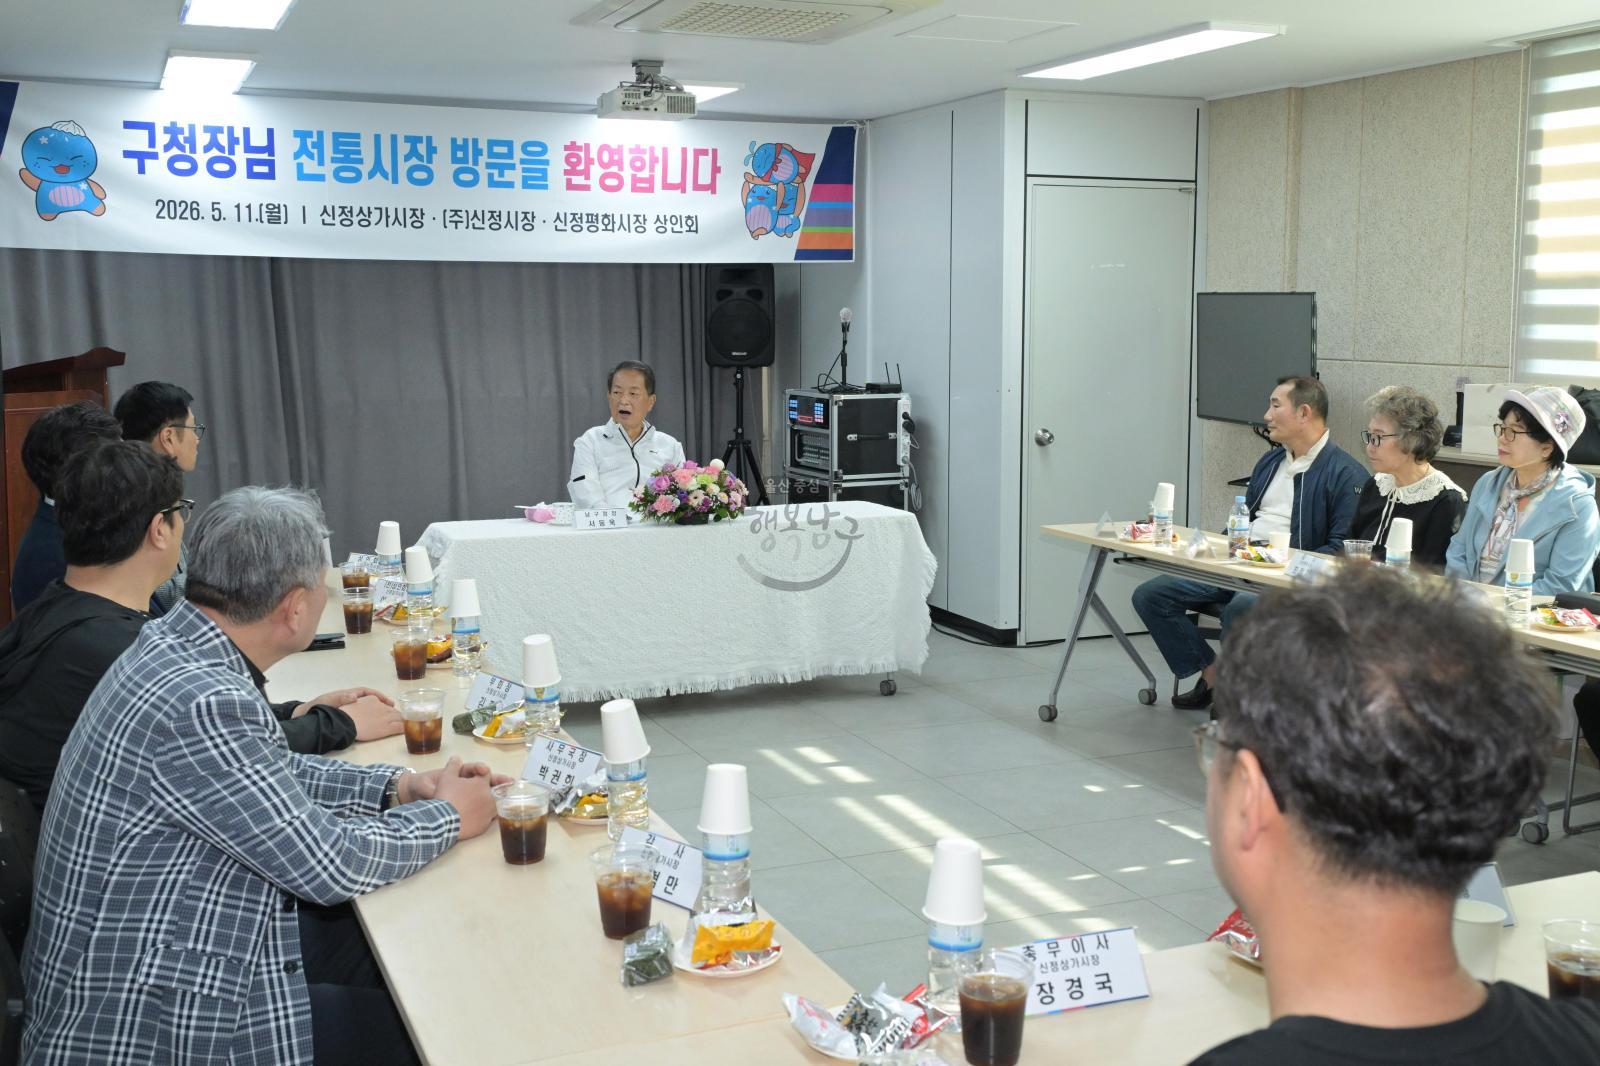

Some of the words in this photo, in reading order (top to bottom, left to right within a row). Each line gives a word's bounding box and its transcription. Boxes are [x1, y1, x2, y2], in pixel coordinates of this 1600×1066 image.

[122, 119, 277, 181] 구청장님
[292, 129, 438, 186] 전통시장
[450, 135, 550, 190] 방문을
[563, 140, 722, 195] 환영합니다
[155, 198, 205, 221] 2026.
[211, 201, 226, 222] 5.
[319, 204, 426, 229] 신정상가시장
[442, 208, 536, 232] (주)신정시장
[553, 211, 648, 234] 신정평화시장
[653, 214, 699, 234] 상인회
[1040, 954, 1101, 975] 신정상가시장
[1036, 972, 1113, 1006] 장경국
